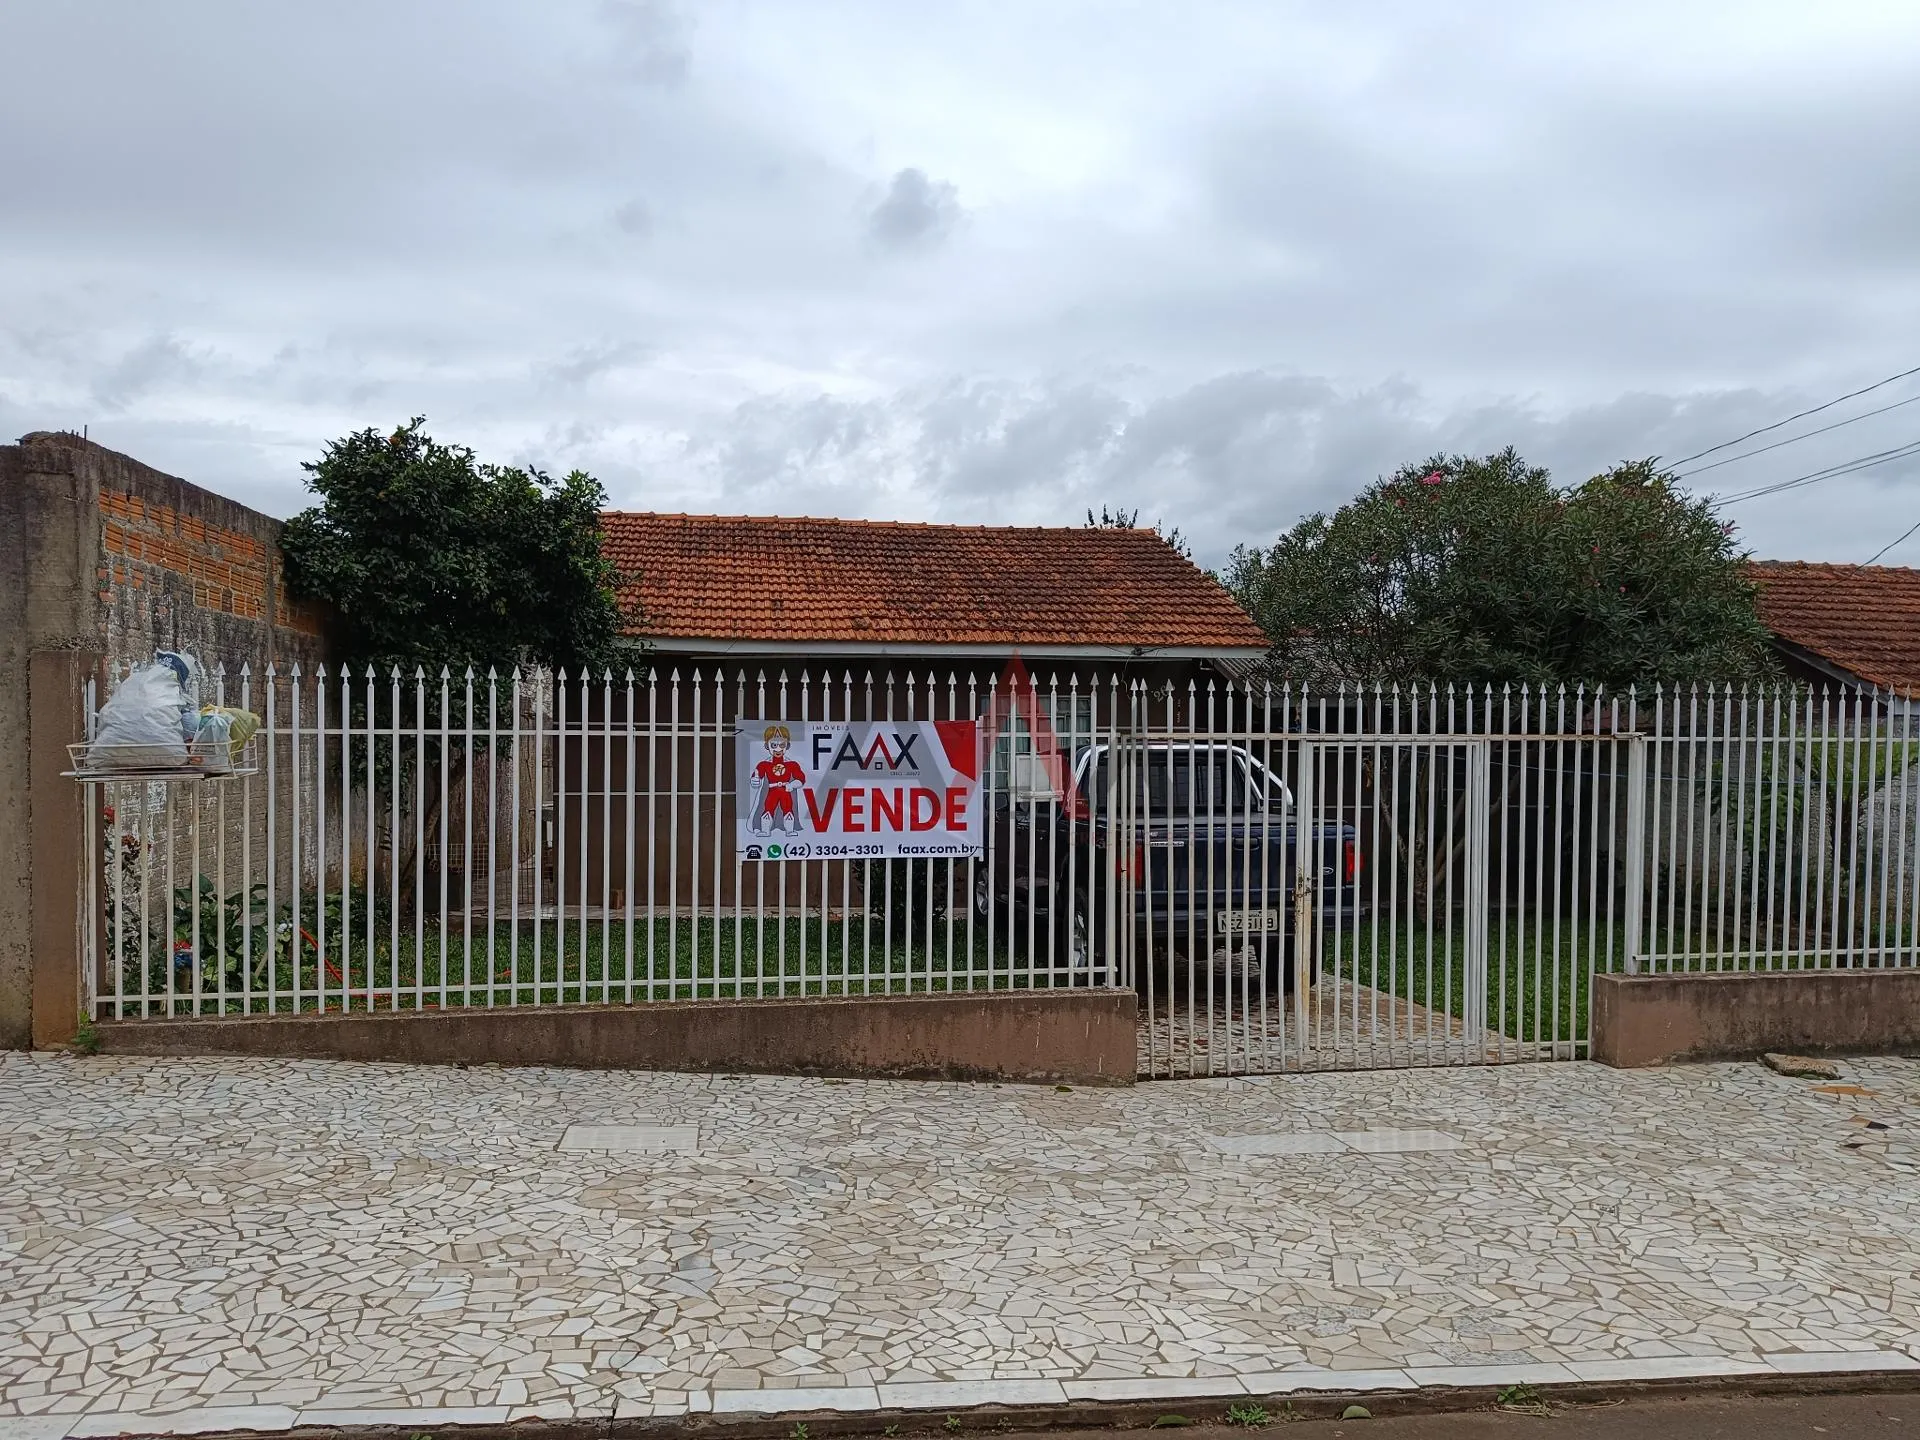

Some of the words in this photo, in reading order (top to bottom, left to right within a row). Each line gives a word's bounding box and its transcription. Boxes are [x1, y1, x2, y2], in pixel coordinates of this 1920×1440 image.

[813, 732, 919, 770] FAAX
[803, 787, 968, 833] VENDE
[783, 843, 811, 858] (42)
[815, 844, 884, 856] 3304-3301
[898, 843, 975, 855] faax.com.br
